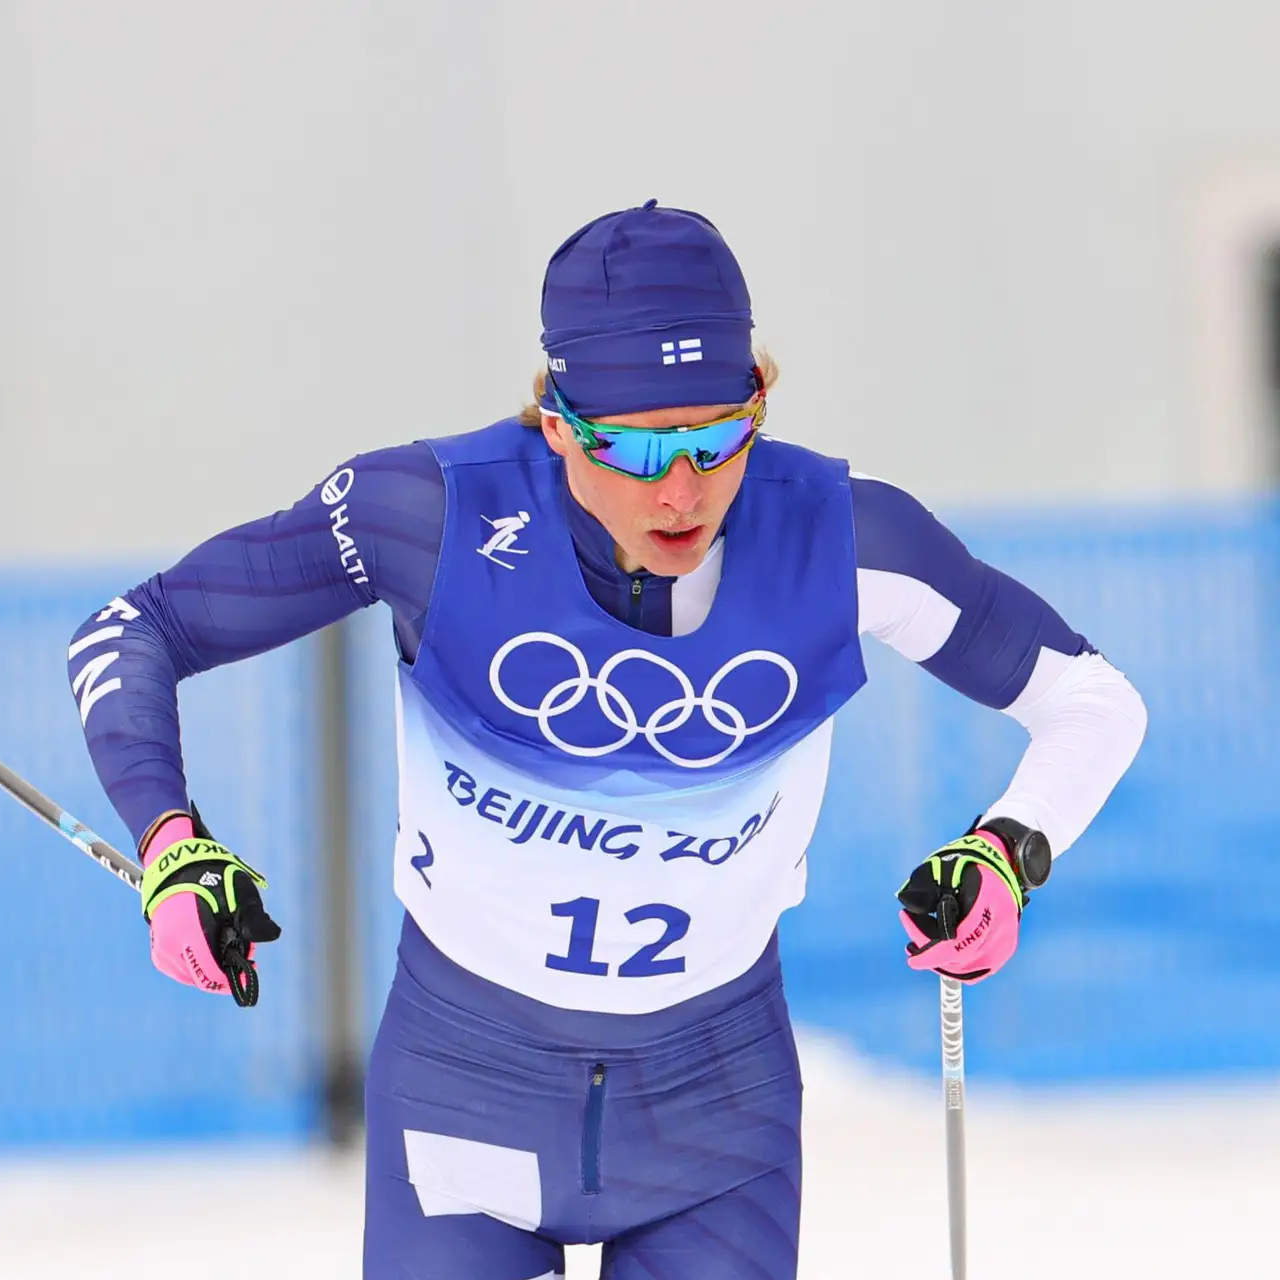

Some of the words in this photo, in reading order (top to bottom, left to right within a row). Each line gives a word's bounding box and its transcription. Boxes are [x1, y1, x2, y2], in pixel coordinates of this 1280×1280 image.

[329, 503, 369, 584] HALTI
[68, 596, 141, 728] FIN
[444, 760, 644, 860] BEIJING
[544, 896, 692, 978] 12
